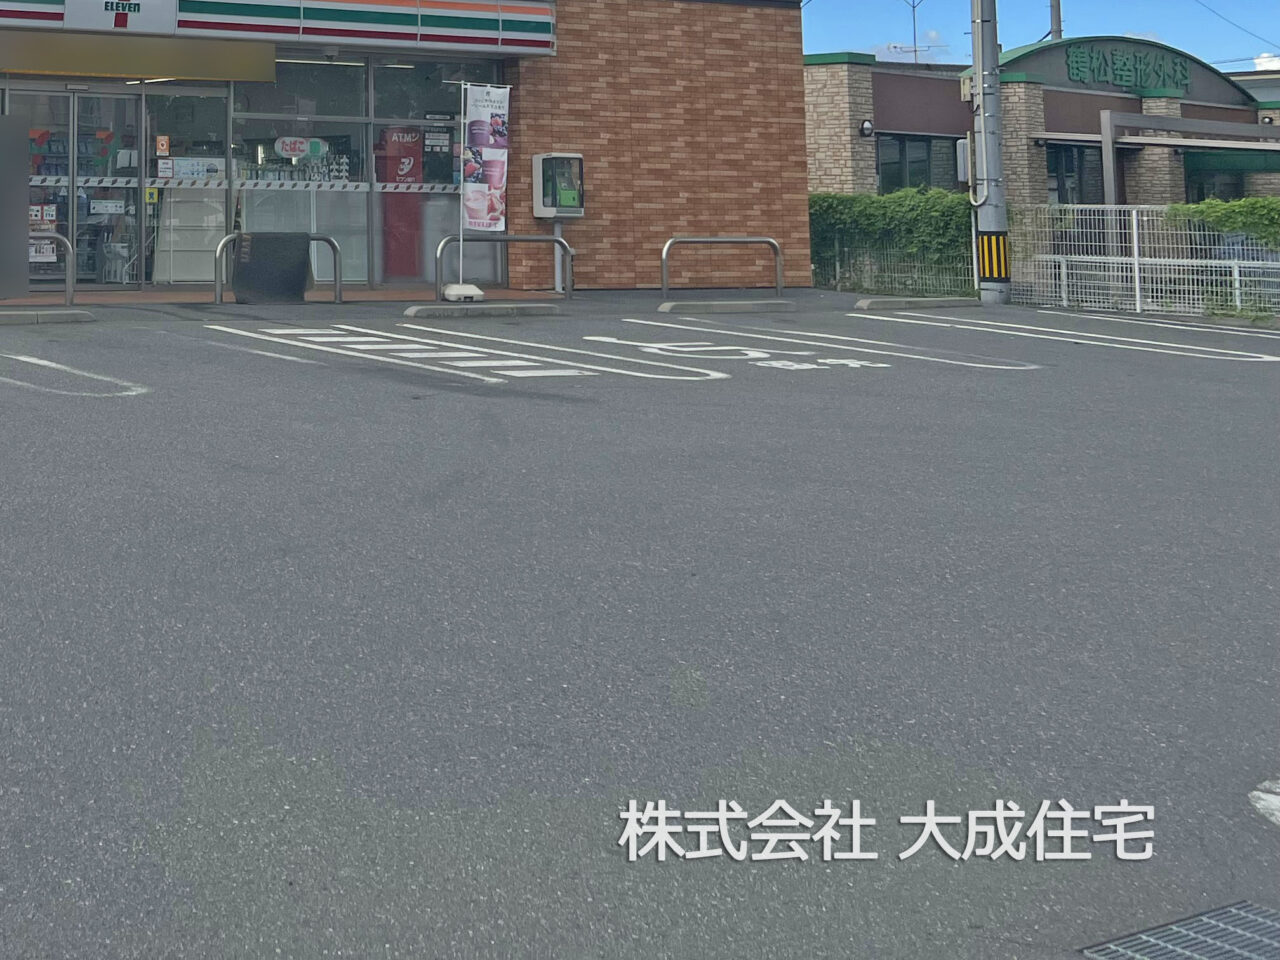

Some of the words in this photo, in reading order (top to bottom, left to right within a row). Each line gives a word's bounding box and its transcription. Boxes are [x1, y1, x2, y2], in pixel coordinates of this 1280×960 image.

[1066, 44, 1190, 93] 鶴松整形外科
[391, 133, 412, 142] ATM
[281, 140, 306, 153] たばこ
